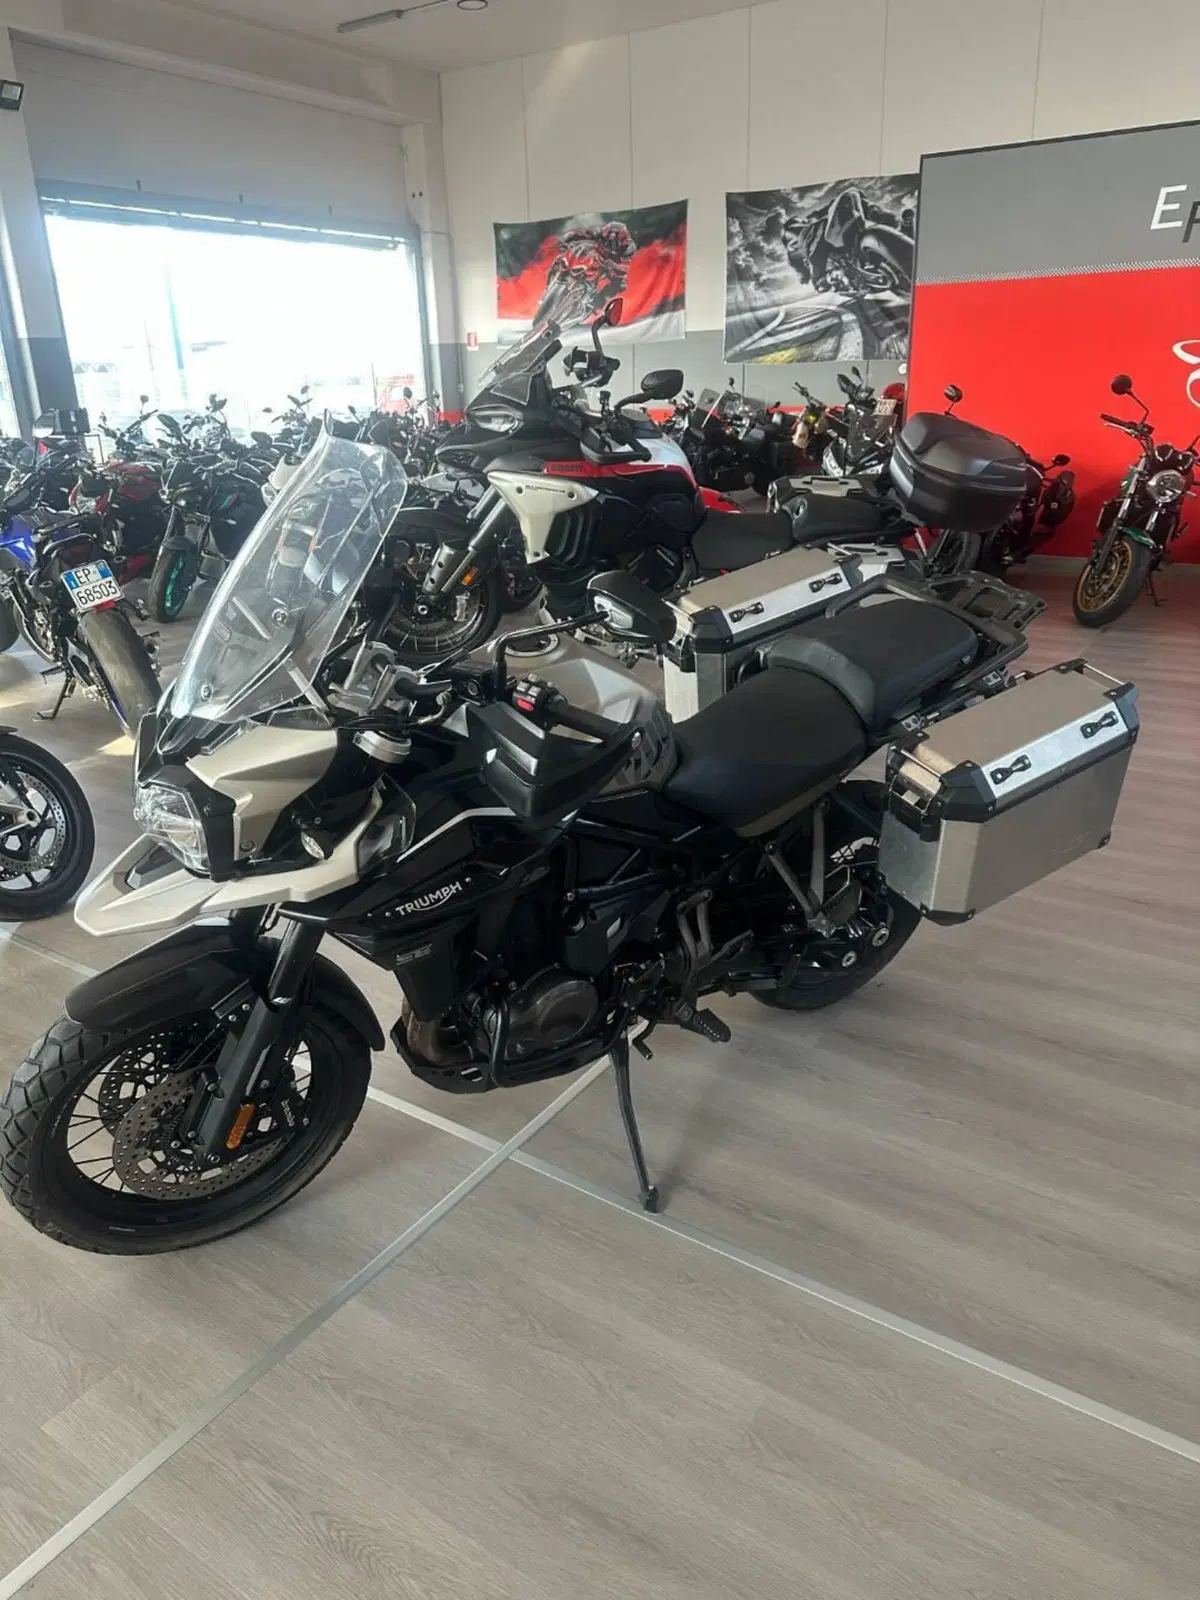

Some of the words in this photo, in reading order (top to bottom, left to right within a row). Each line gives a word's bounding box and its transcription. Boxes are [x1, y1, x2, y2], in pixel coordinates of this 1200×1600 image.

[74, 568, 91, 585] EP
[76, 581, 118, 605] 68503
[395, 881, 462, 916] TRIUMPH
